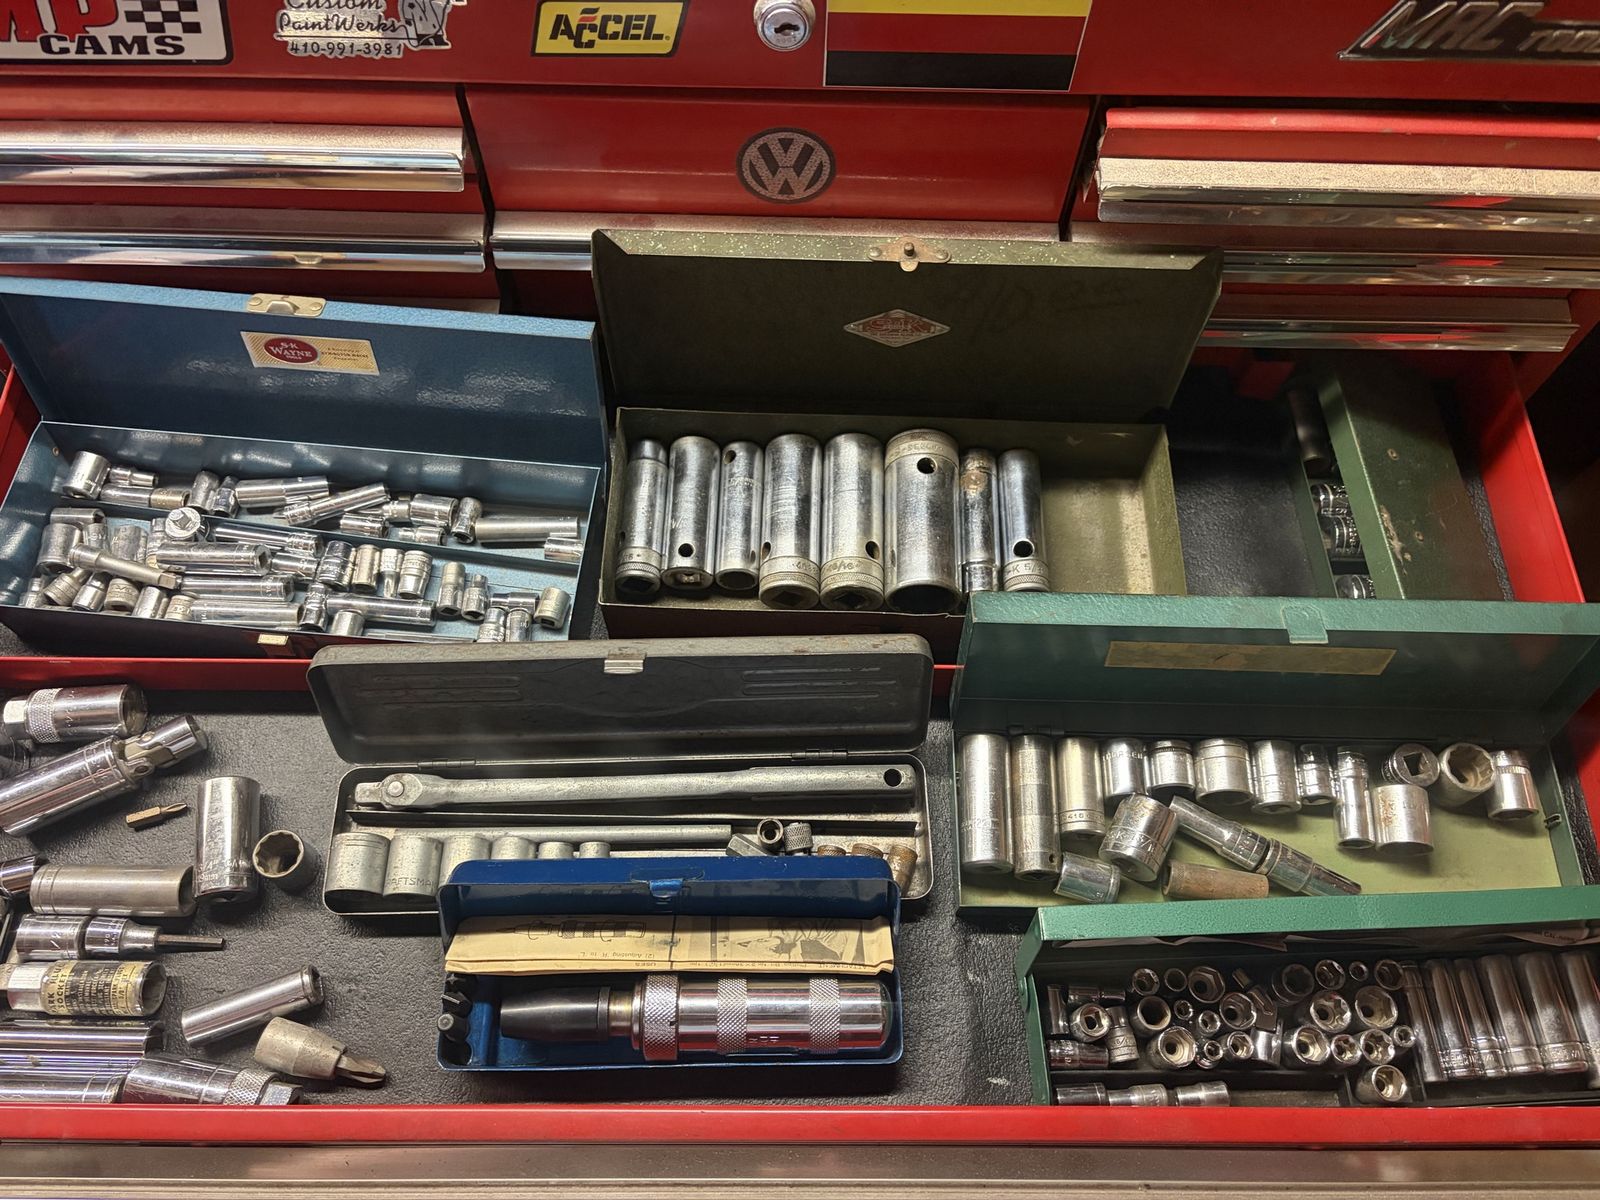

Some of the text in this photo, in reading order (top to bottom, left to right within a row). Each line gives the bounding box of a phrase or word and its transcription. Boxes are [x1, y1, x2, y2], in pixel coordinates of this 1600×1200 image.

[548, 13, 665, 49] ACCEL
[39, 34, 186, 56] CAMS
[290, 41, 402, 57] 410-991-3981
[269, 345, 312, 357] WAYNE
[56, 973, 68, 1011] SOCKET
